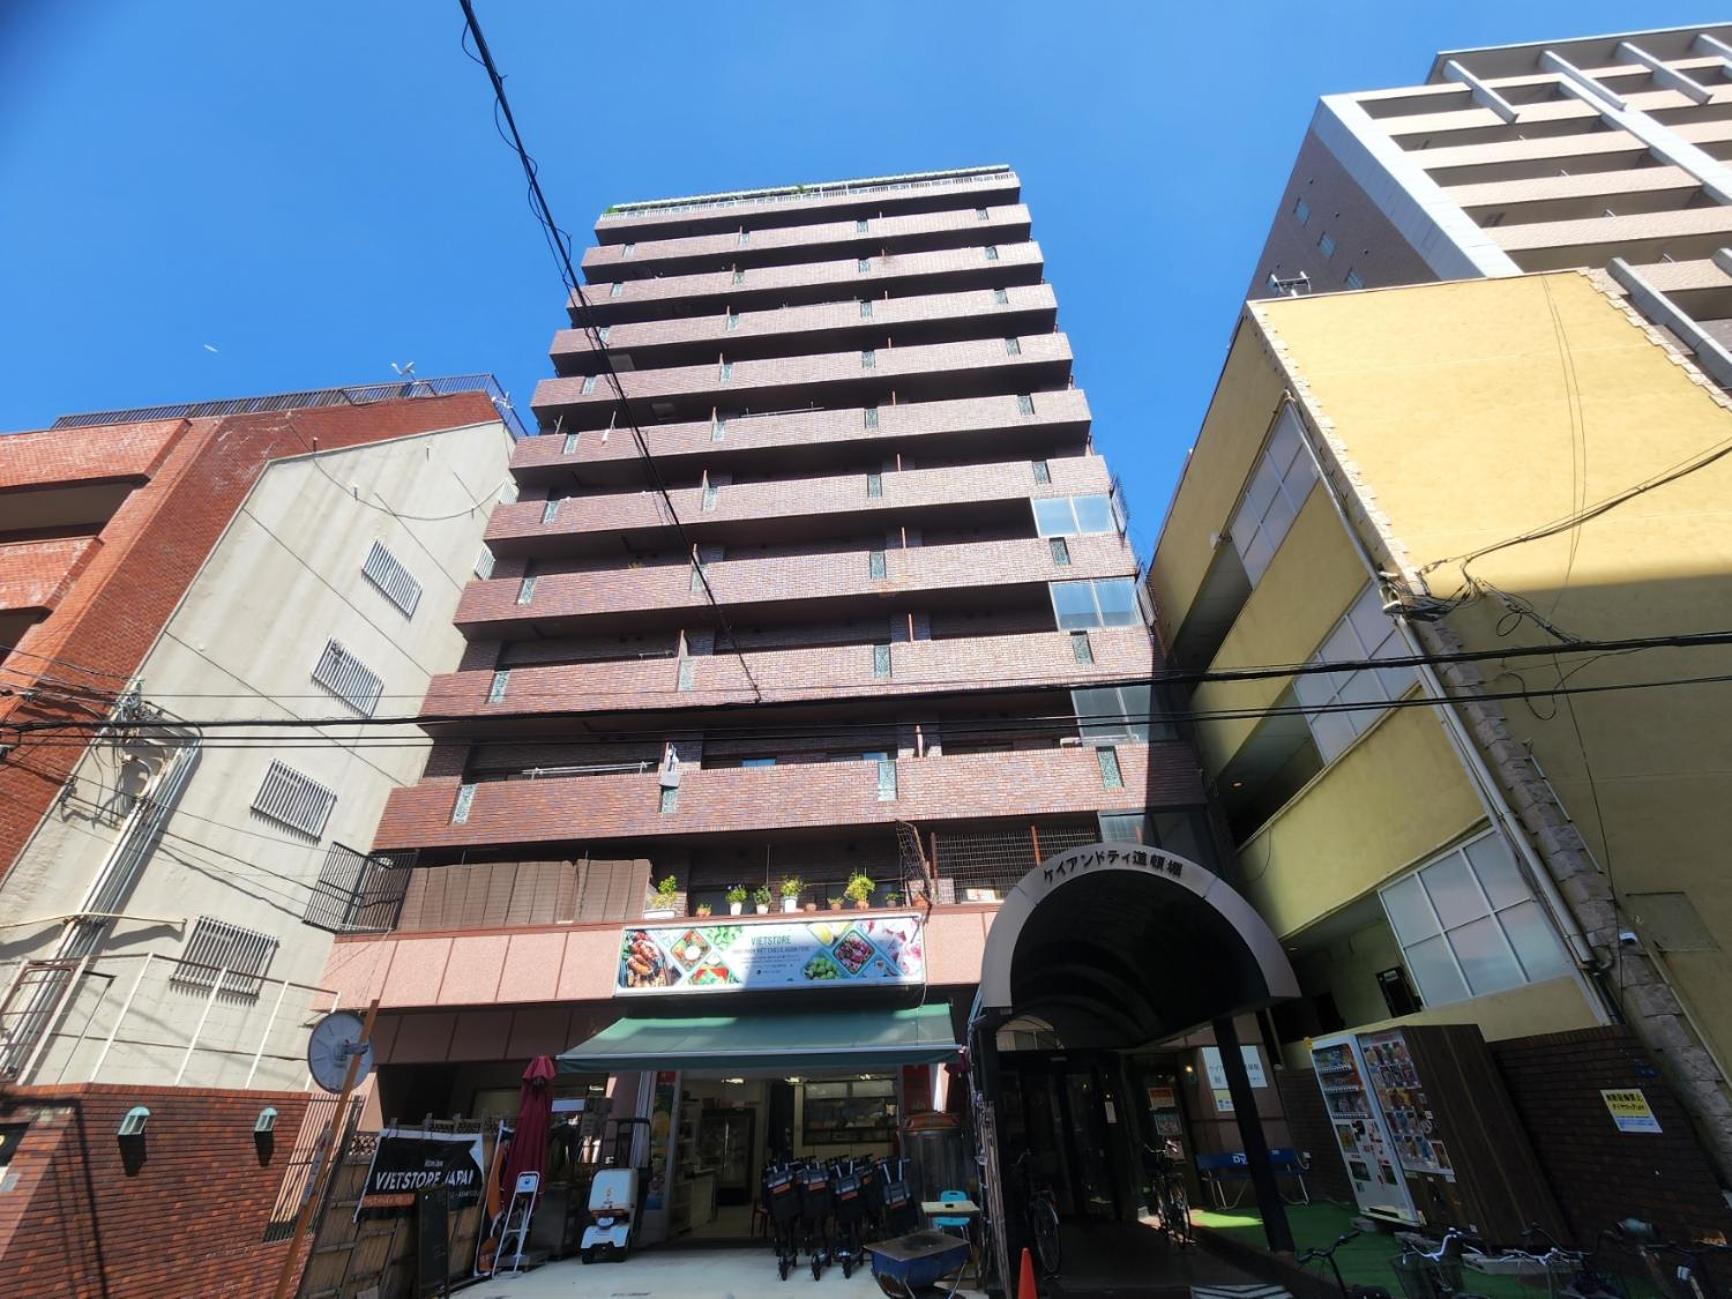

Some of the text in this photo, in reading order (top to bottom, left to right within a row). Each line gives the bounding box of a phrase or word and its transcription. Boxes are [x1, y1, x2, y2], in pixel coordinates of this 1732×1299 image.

[1043, 850, 1183, 883] ケイアンドティ道頓堀
[751, 935, 792, 945] VIETSTORE
[375, 1171, 442, 1190] VIETSTORE
